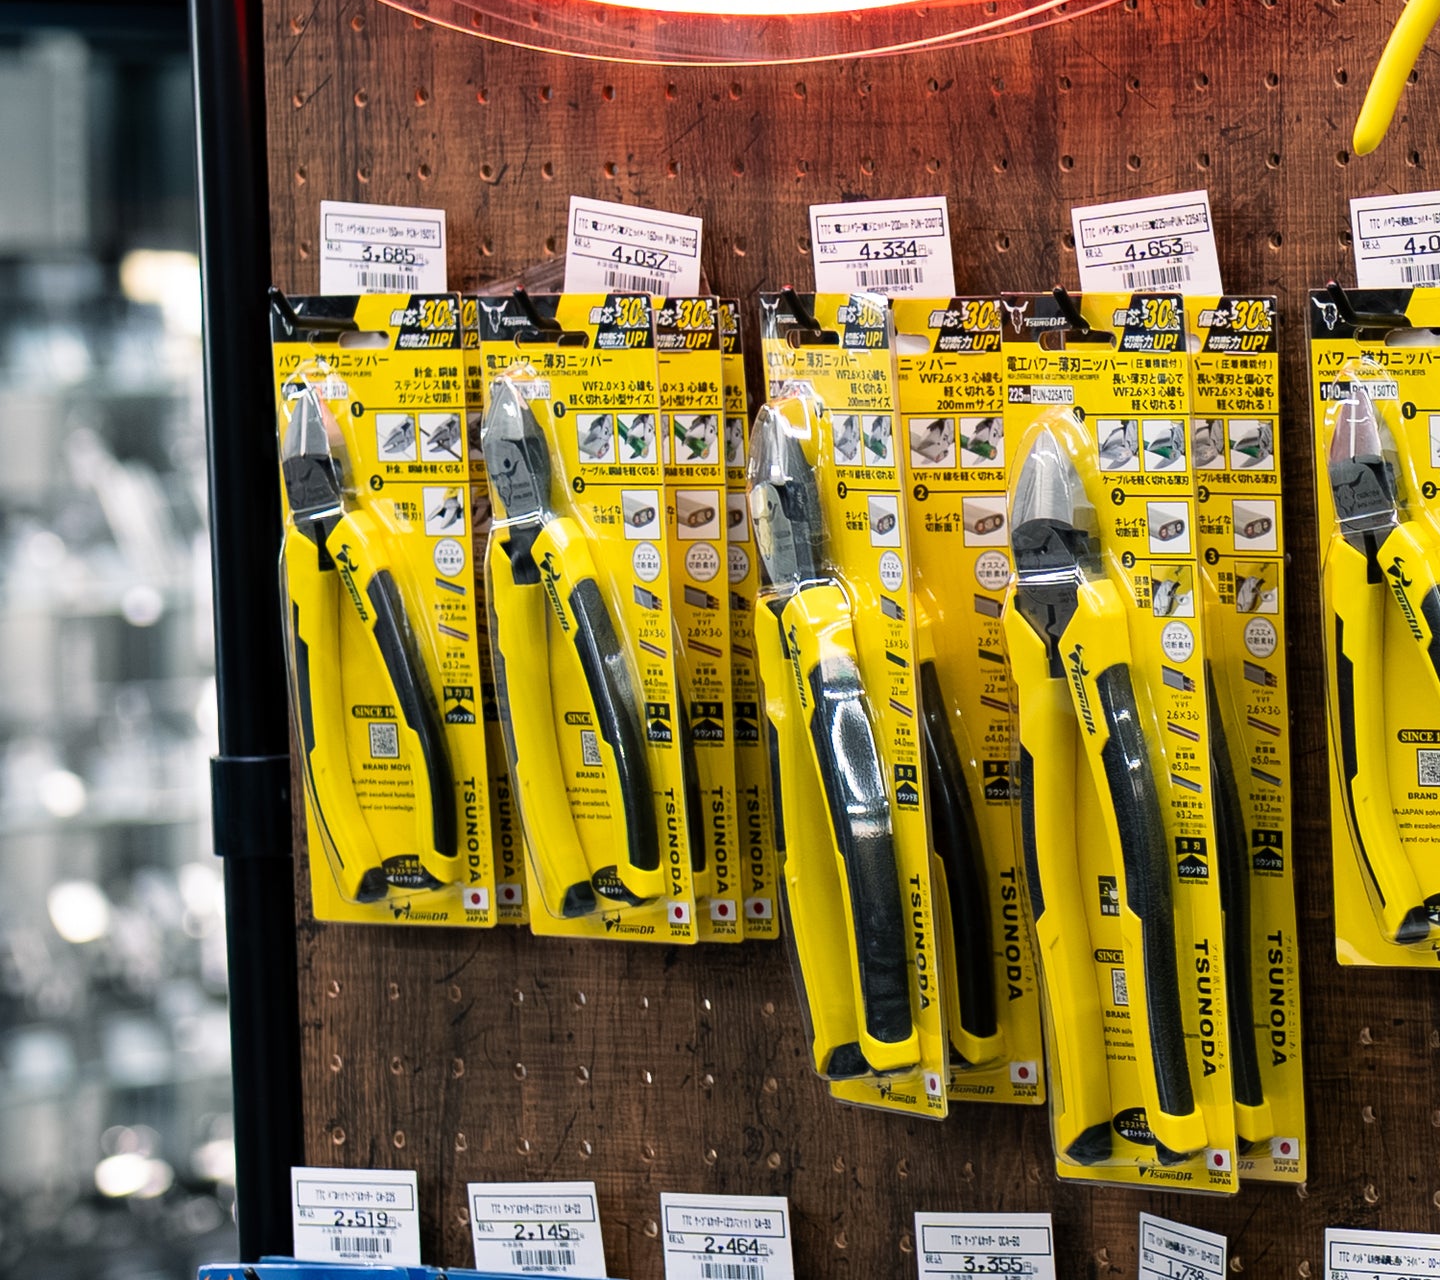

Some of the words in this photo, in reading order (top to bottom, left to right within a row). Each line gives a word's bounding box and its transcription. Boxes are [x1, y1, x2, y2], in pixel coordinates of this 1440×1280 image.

[1401, 730, 1429, 742] SINCE
[1407, 792, 1438, 801] BRAND
[463, 776, 480, 884] TSUNODA
[665, 787, 683, 897] TSUNODA
[909, 873, 930, 1012] TSUNODA
[1000, 866, 1022, 1003] TSUNODA
[1195, 938, 1216, 1078] TSUNODA
[1268, 930, 1286, 1068] TSUNODA
